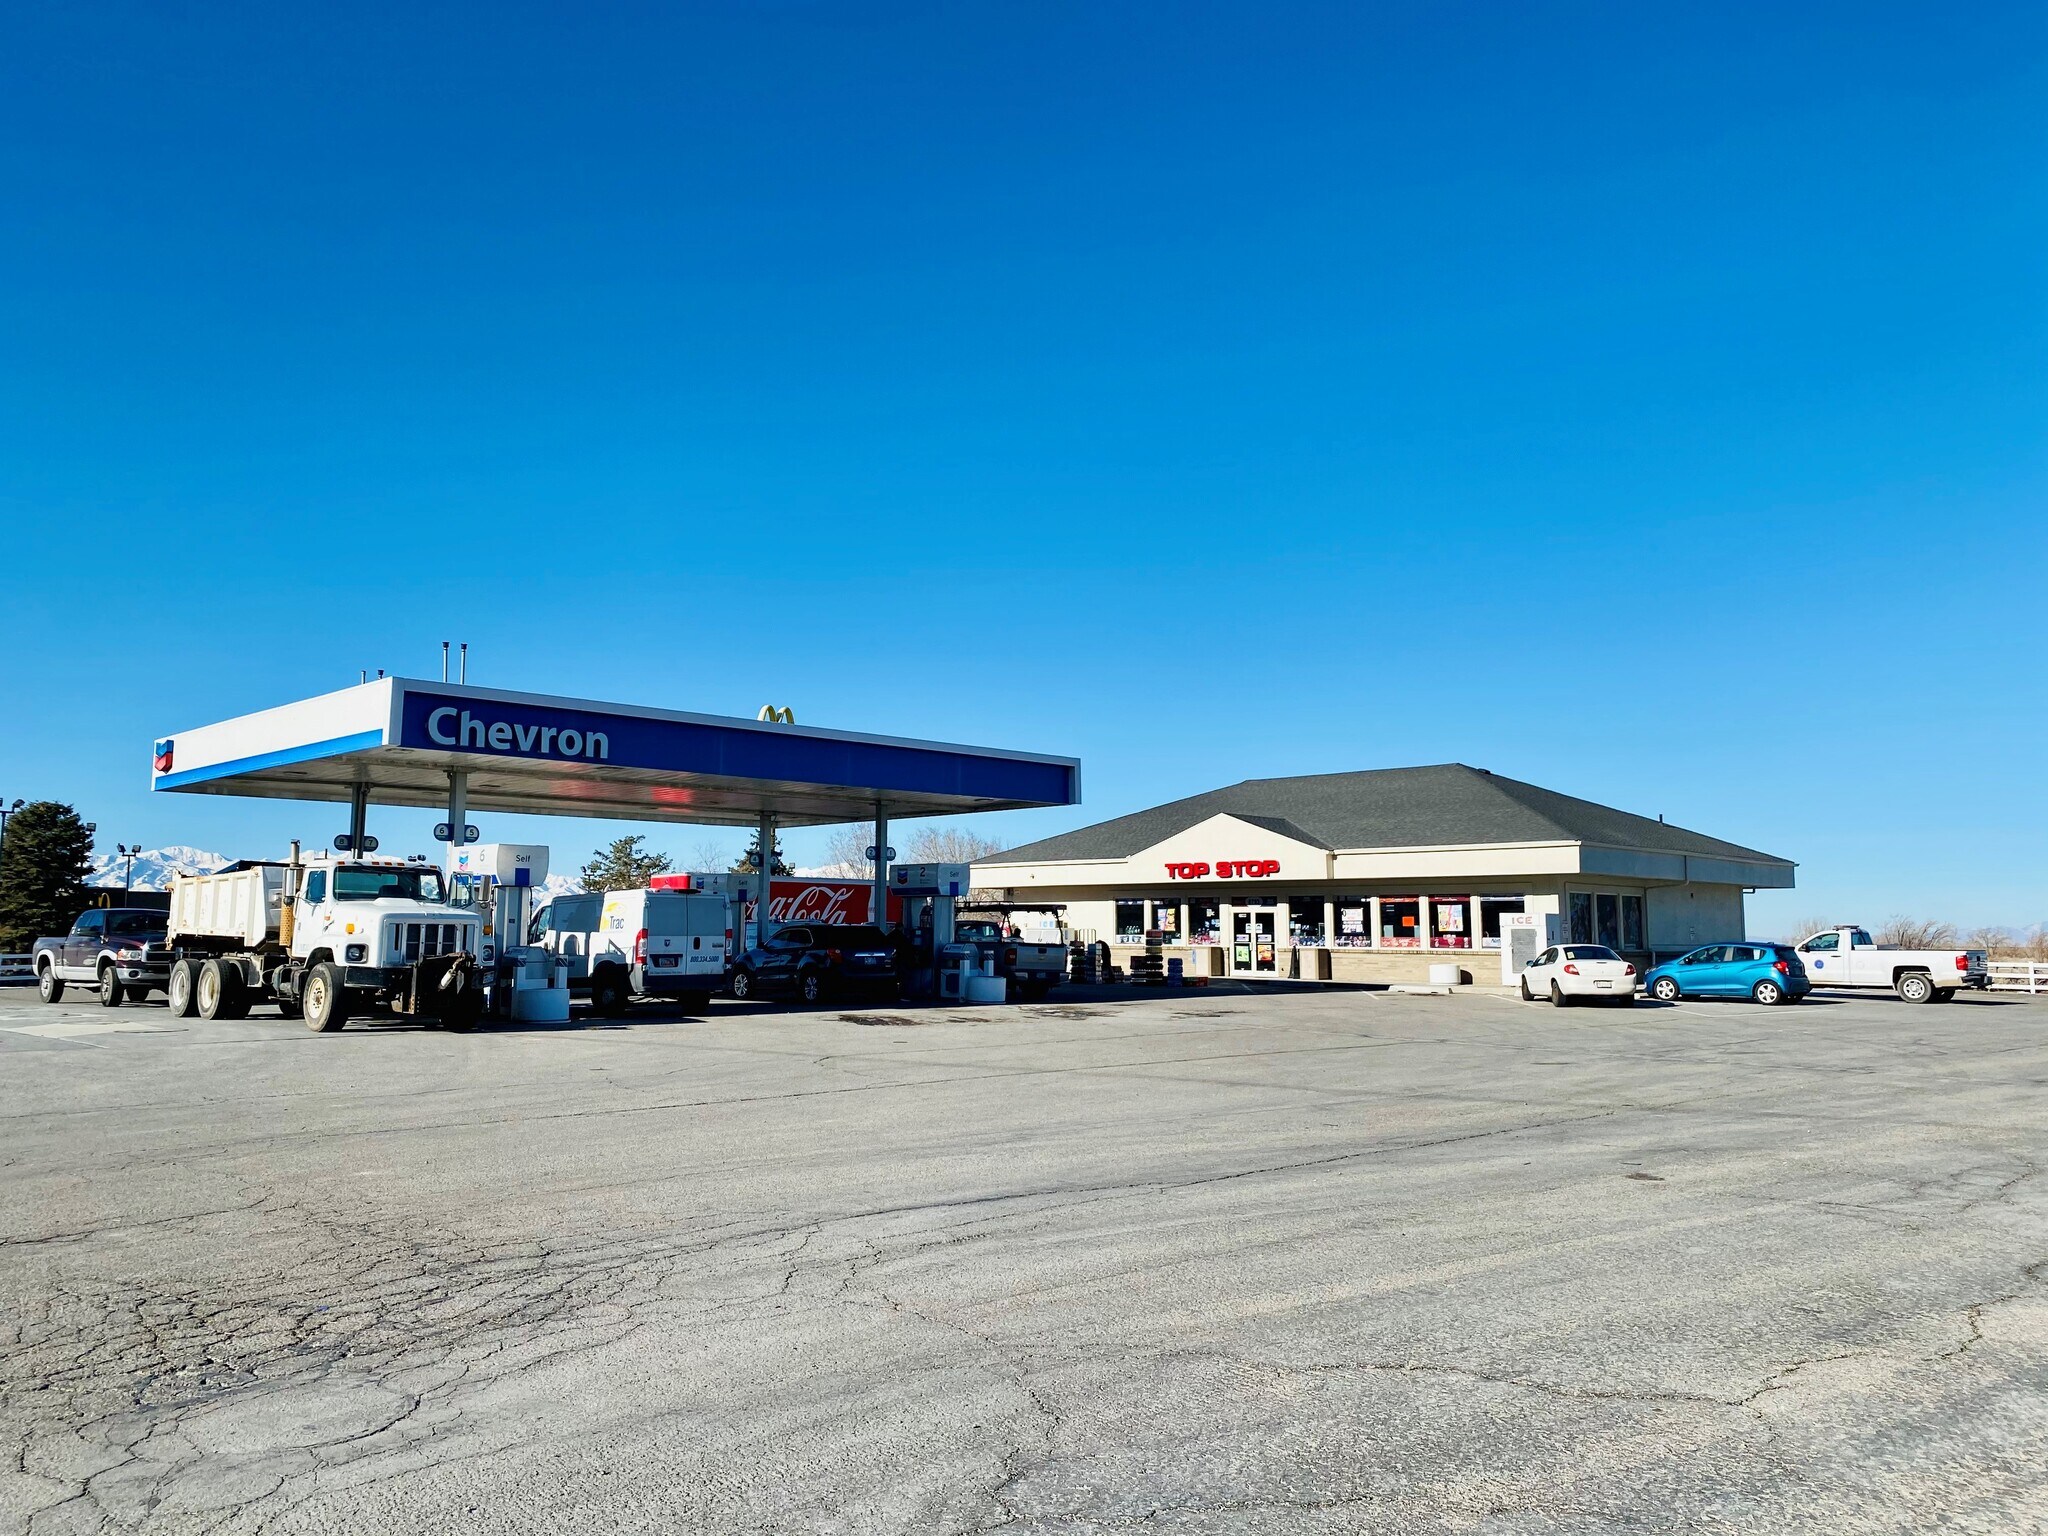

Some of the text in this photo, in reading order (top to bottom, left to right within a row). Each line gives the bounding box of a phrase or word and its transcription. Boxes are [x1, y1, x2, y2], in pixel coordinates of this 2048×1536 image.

[428, 706, 609, 759] Chevron
[439, 826, 445, 834] 6
[469, 828, 475, 836] 5
[480, 849, 485, 862] 6
[515, 854, 531, 863] Self
[920, 867, 926, 877] 2
[949, 870, 960, 878] Self
[1165, 860, 1280, 879] TOP STOP
[713, 876, 718, 885] 4
[1512, 916, 1533, 925] ICE
